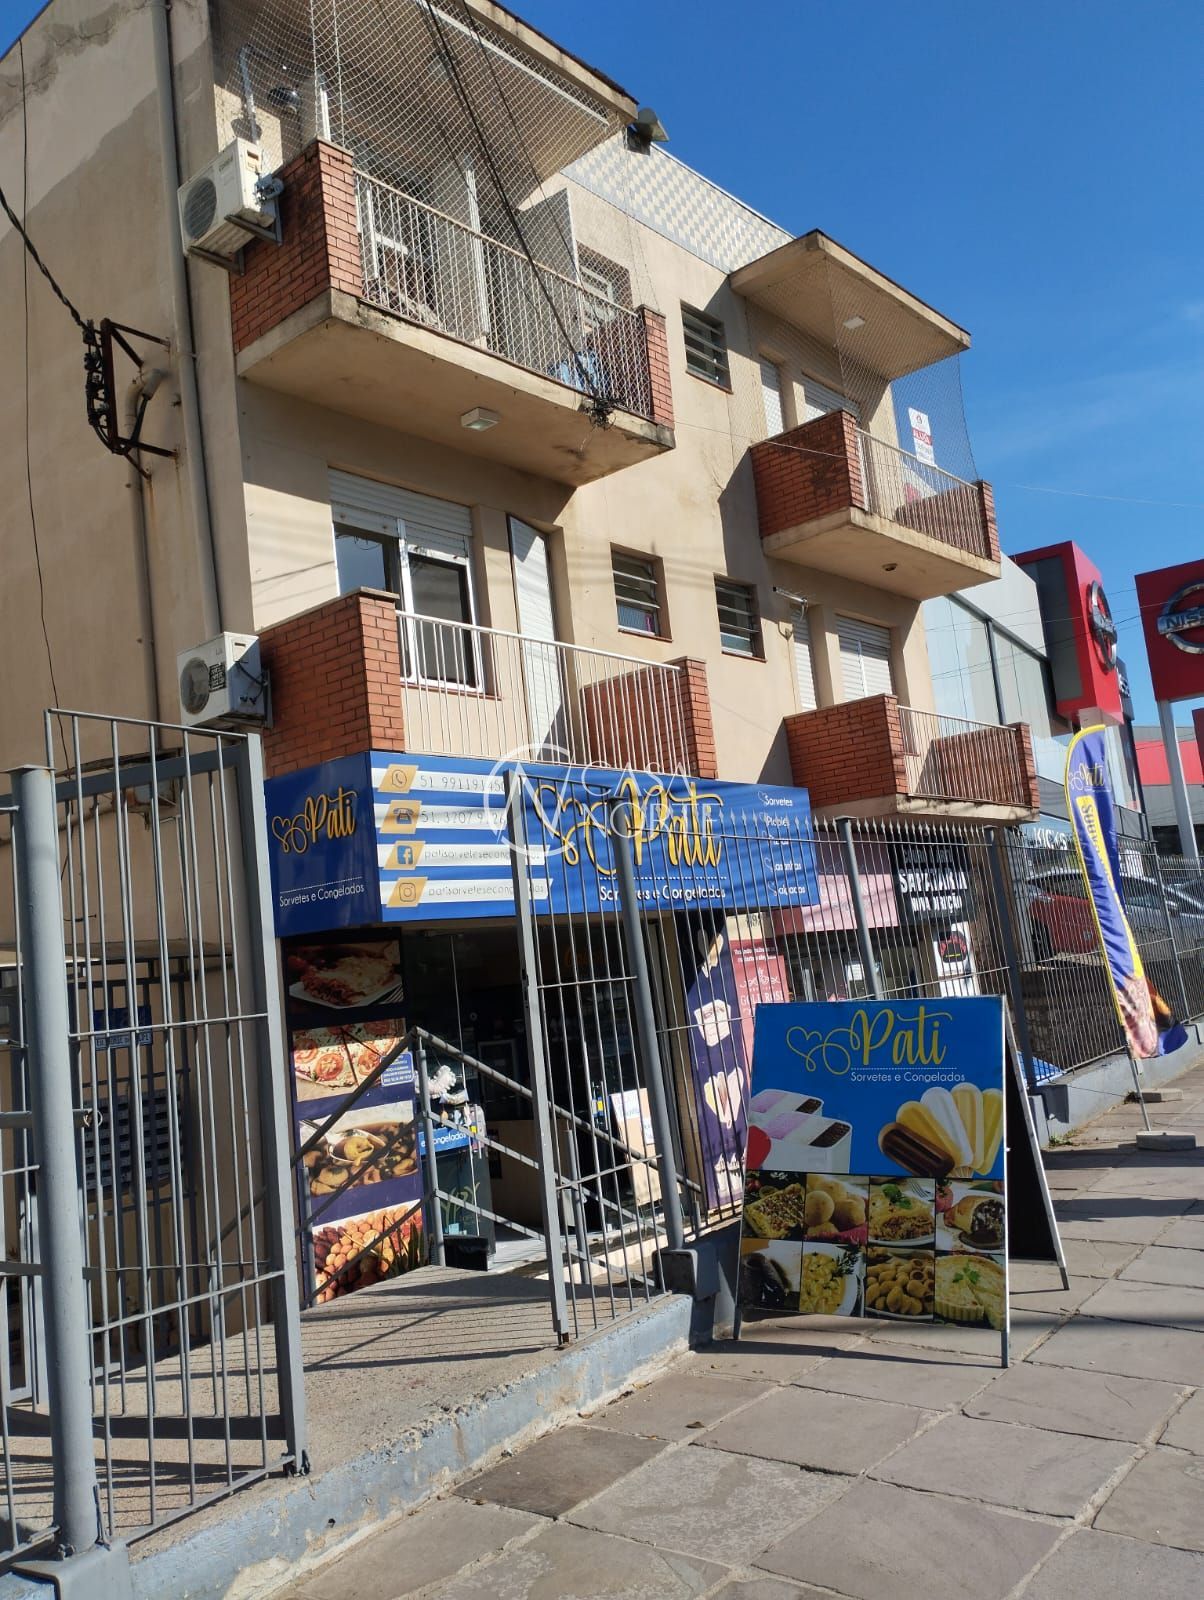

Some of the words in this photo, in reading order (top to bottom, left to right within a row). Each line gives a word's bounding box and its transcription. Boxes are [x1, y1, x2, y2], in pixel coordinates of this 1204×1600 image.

[420, 775, 434, 788] 51
[765, 794, 793, 807] Sorvetes
[305, 786, 357, 843] Pati
[280, 892, 310, 907] Sorvetes
[311, 892, 317, 901] e
[318, 883, 365, 899] Congelados
[600, 886, 651, 901] Sores
[850, 1005, 953, 1066] Pati
[850, 1071, 892, 1082] Sorvetes
[894, 1073, 901, 1082] e
[903, 1071, 966, 1083] Congelados
[432, 1131, 467, 1146] ongelados
